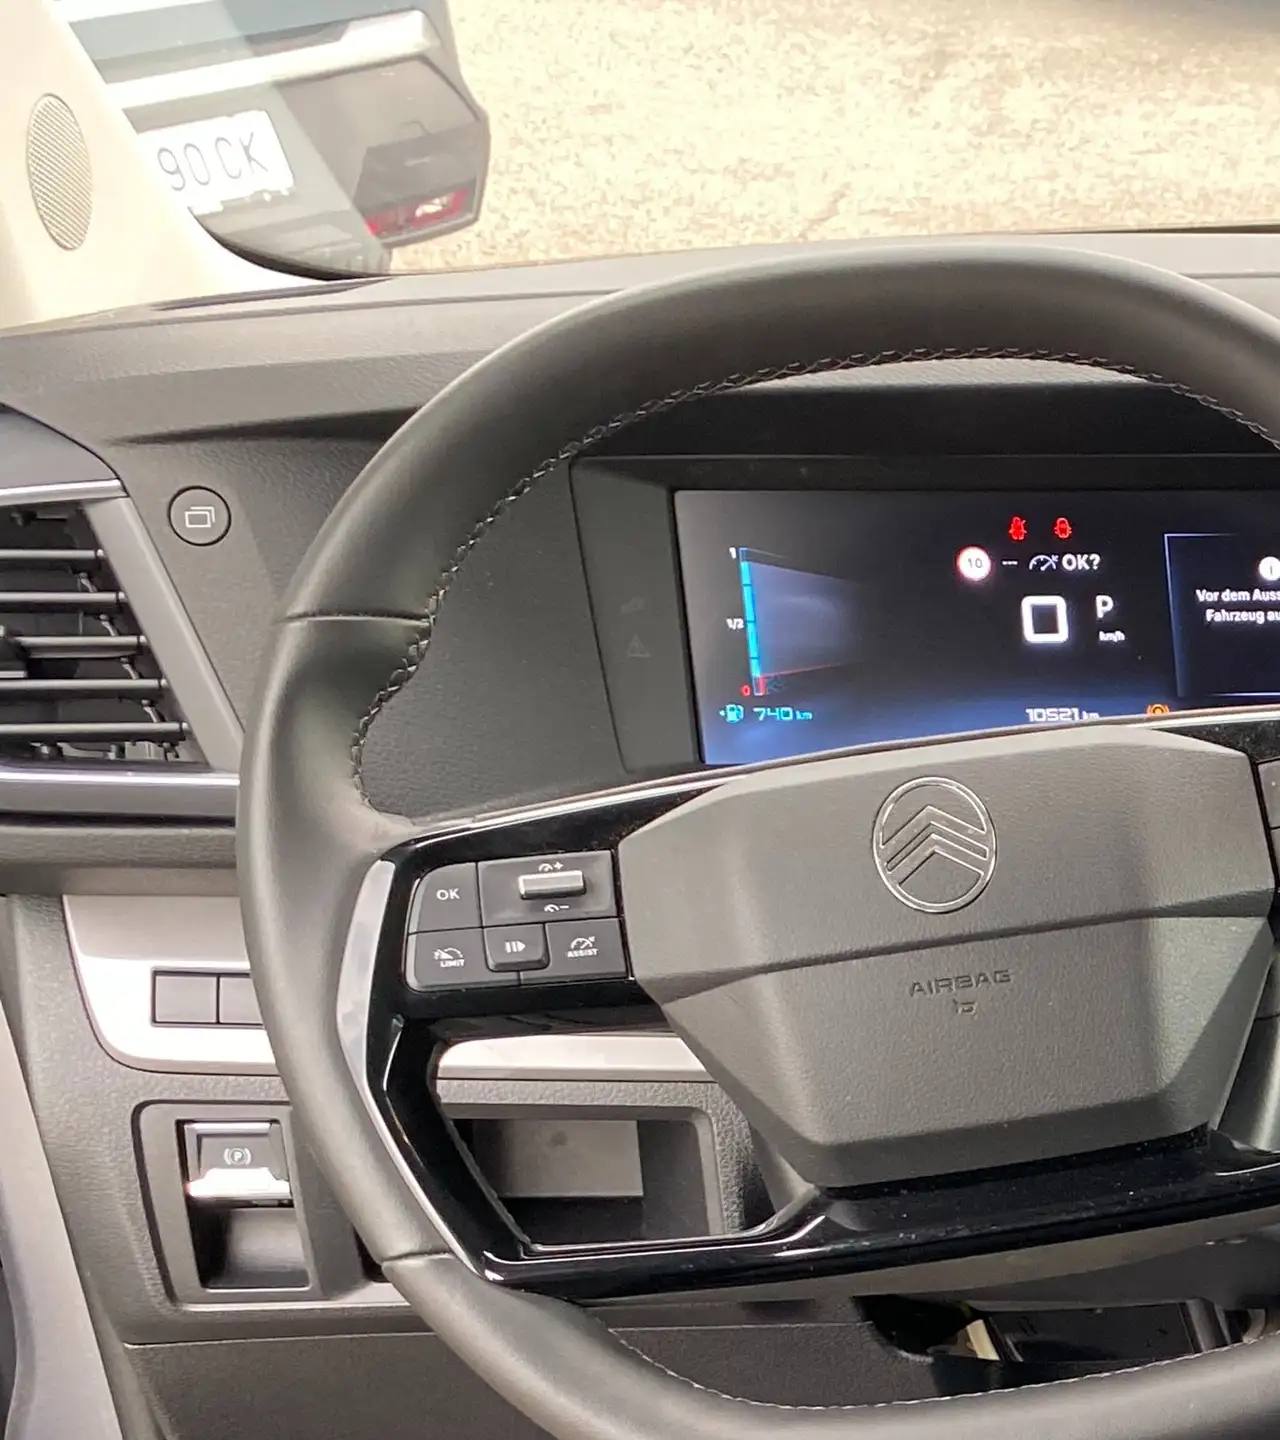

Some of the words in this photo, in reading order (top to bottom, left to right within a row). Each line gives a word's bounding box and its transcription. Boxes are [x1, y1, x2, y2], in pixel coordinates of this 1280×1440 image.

[967, 557, 983, 569] 10
[1062, 553, 1101, 571] OK?
[1196, 589, 1219, 602] Vor
[1221, 588, 1250, 601] dem
[1096, 595, 1114, 618] P
[1021, 595, 1069, 644] 0
[1205, 608, 1265, 624] Fahrzeug
[753, 707, 793, 721] 740
[796, 712, 813, 720] km
[1026, 708, 1081, 722] 10521
[1082, 711, 1100, 721] km
[436, 888, 460, 900] OK
[567, 948, 599, 958] ASSIST
[440, 959, 465, 968] LIMIT
[909, 969, 1012, 998] AIRBAG
